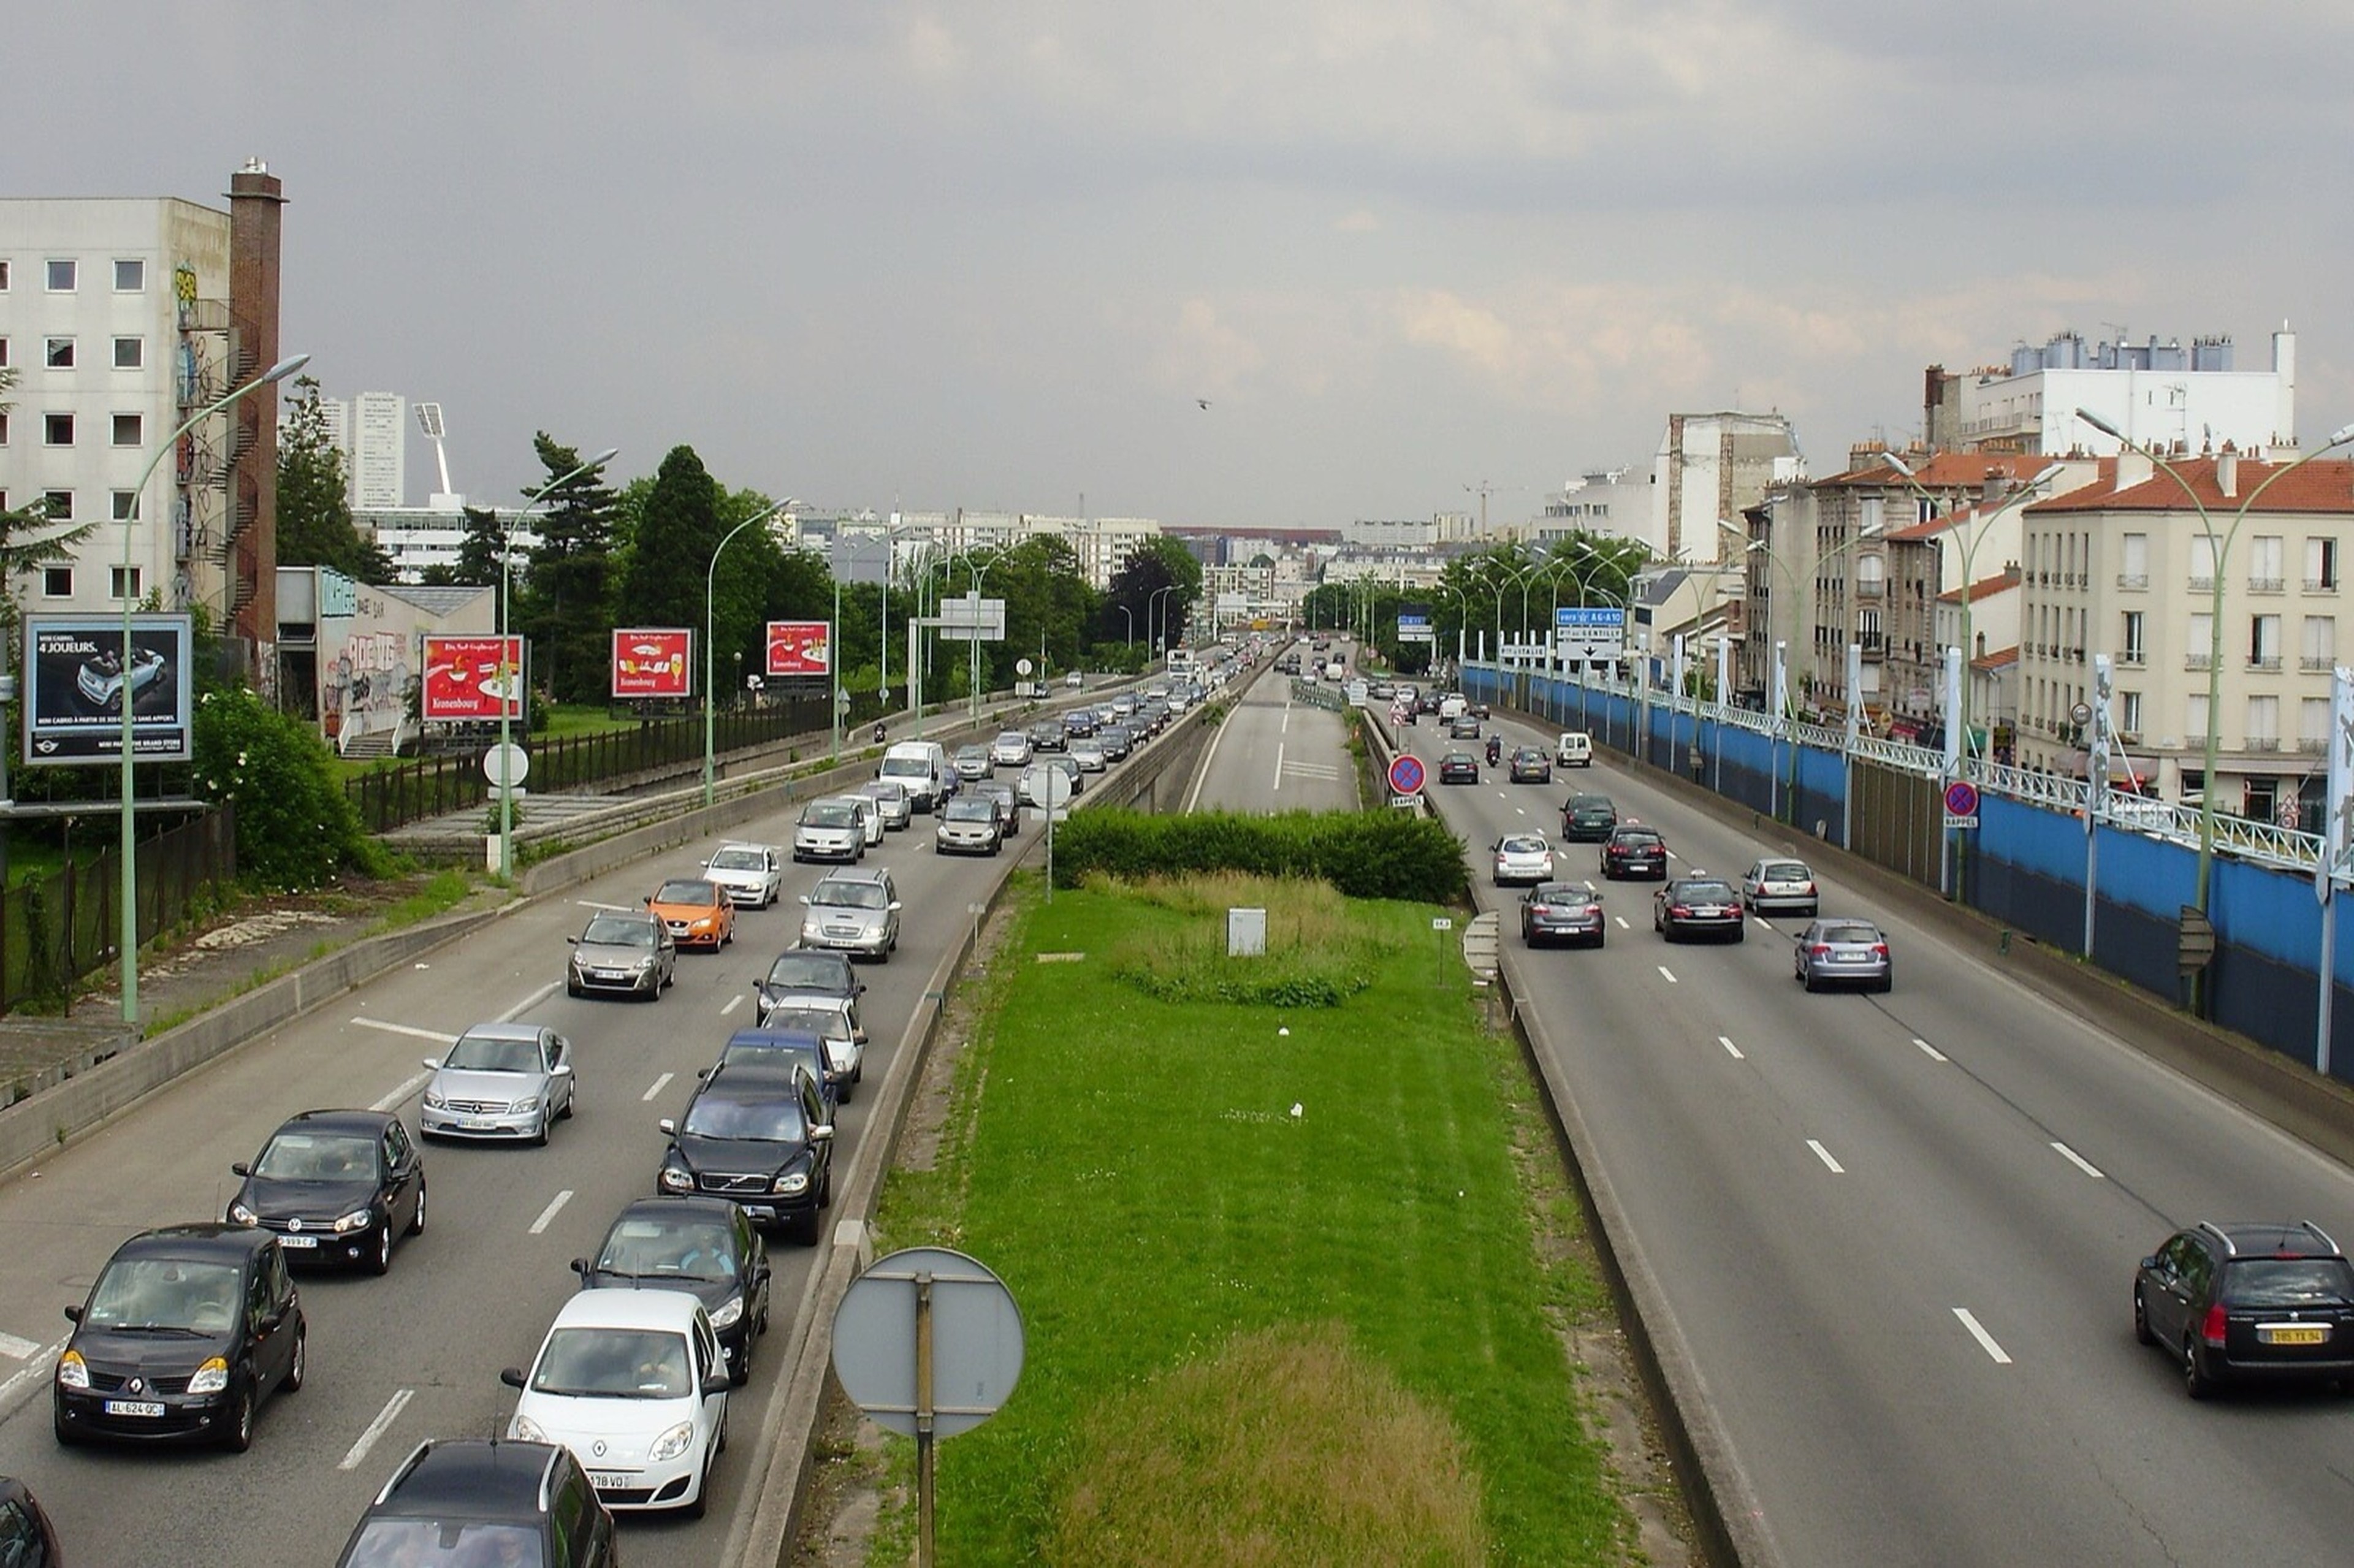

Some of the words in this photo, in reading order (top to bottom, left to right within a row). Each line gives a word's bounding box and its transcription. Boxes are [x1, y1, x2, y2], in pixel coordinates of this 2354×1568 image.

[39, 642, 46, 653] 4
[47, 641, 97, 654] JOUEURS.
[432, 697, 478, 710] Kronenbourg
[126, 1402, 143, 1414] 624
